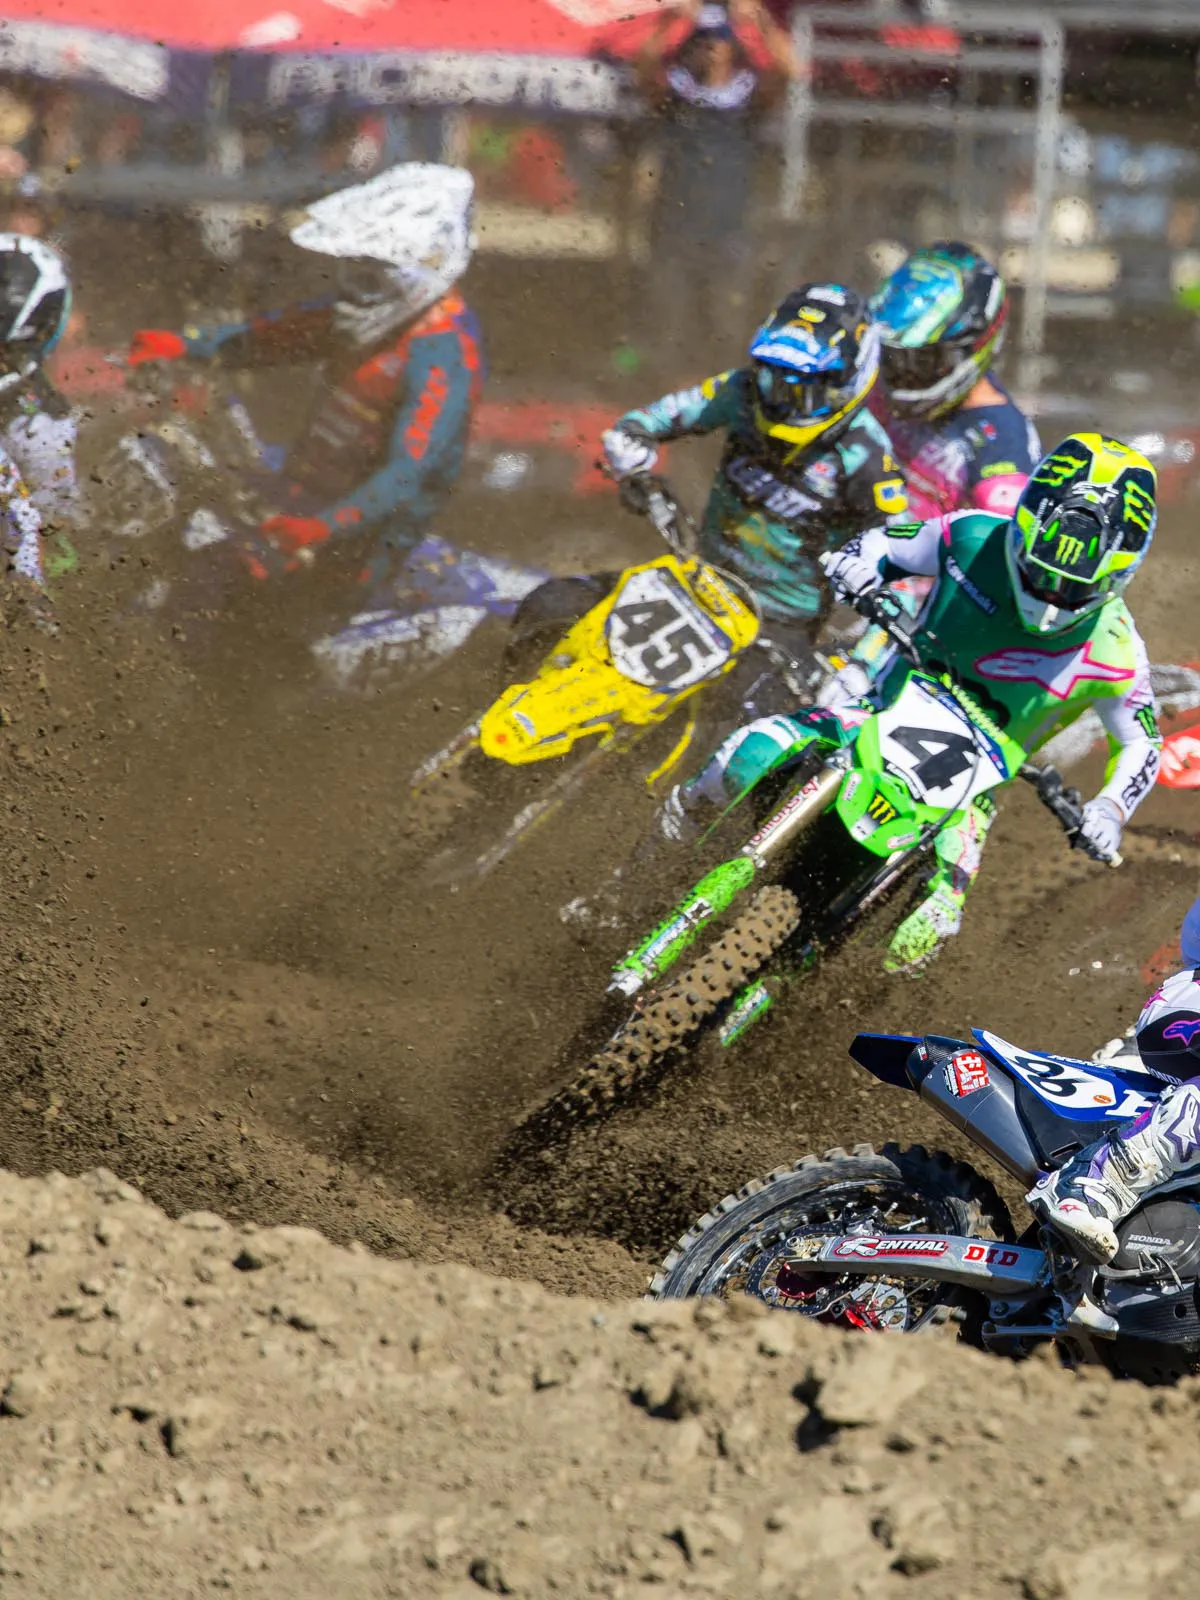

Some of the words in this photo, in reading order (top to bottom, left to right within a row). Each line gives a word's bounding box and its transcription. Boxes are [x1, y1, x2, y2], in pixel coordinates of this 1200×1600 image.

[612, 598, 711, 682] 45
[888, 726, 981, 791] 4
[837, 1237, 946, 1257] RENTHAL
[1127, 1234, 1172, 1246] HONDA
